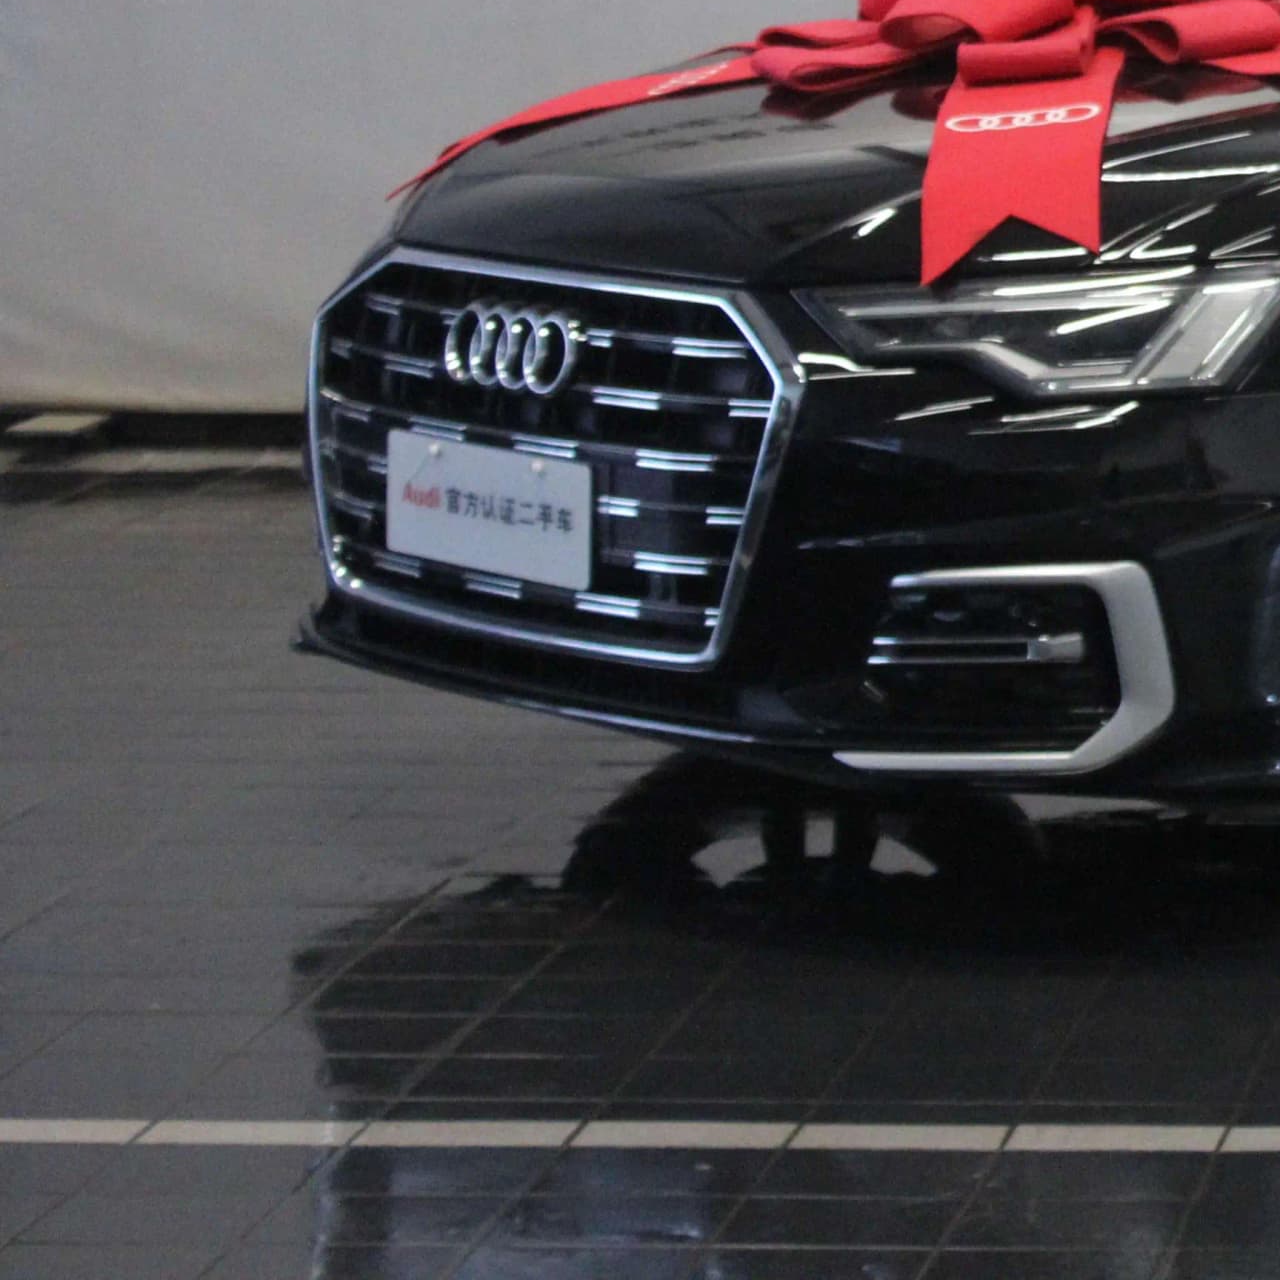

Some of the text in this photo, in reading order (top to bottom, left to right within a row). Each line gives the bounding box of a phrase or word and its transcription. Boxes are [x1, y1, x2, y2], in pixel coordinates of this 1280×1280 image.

[403, 482, 574, 534] Audi 官方认证二手车
